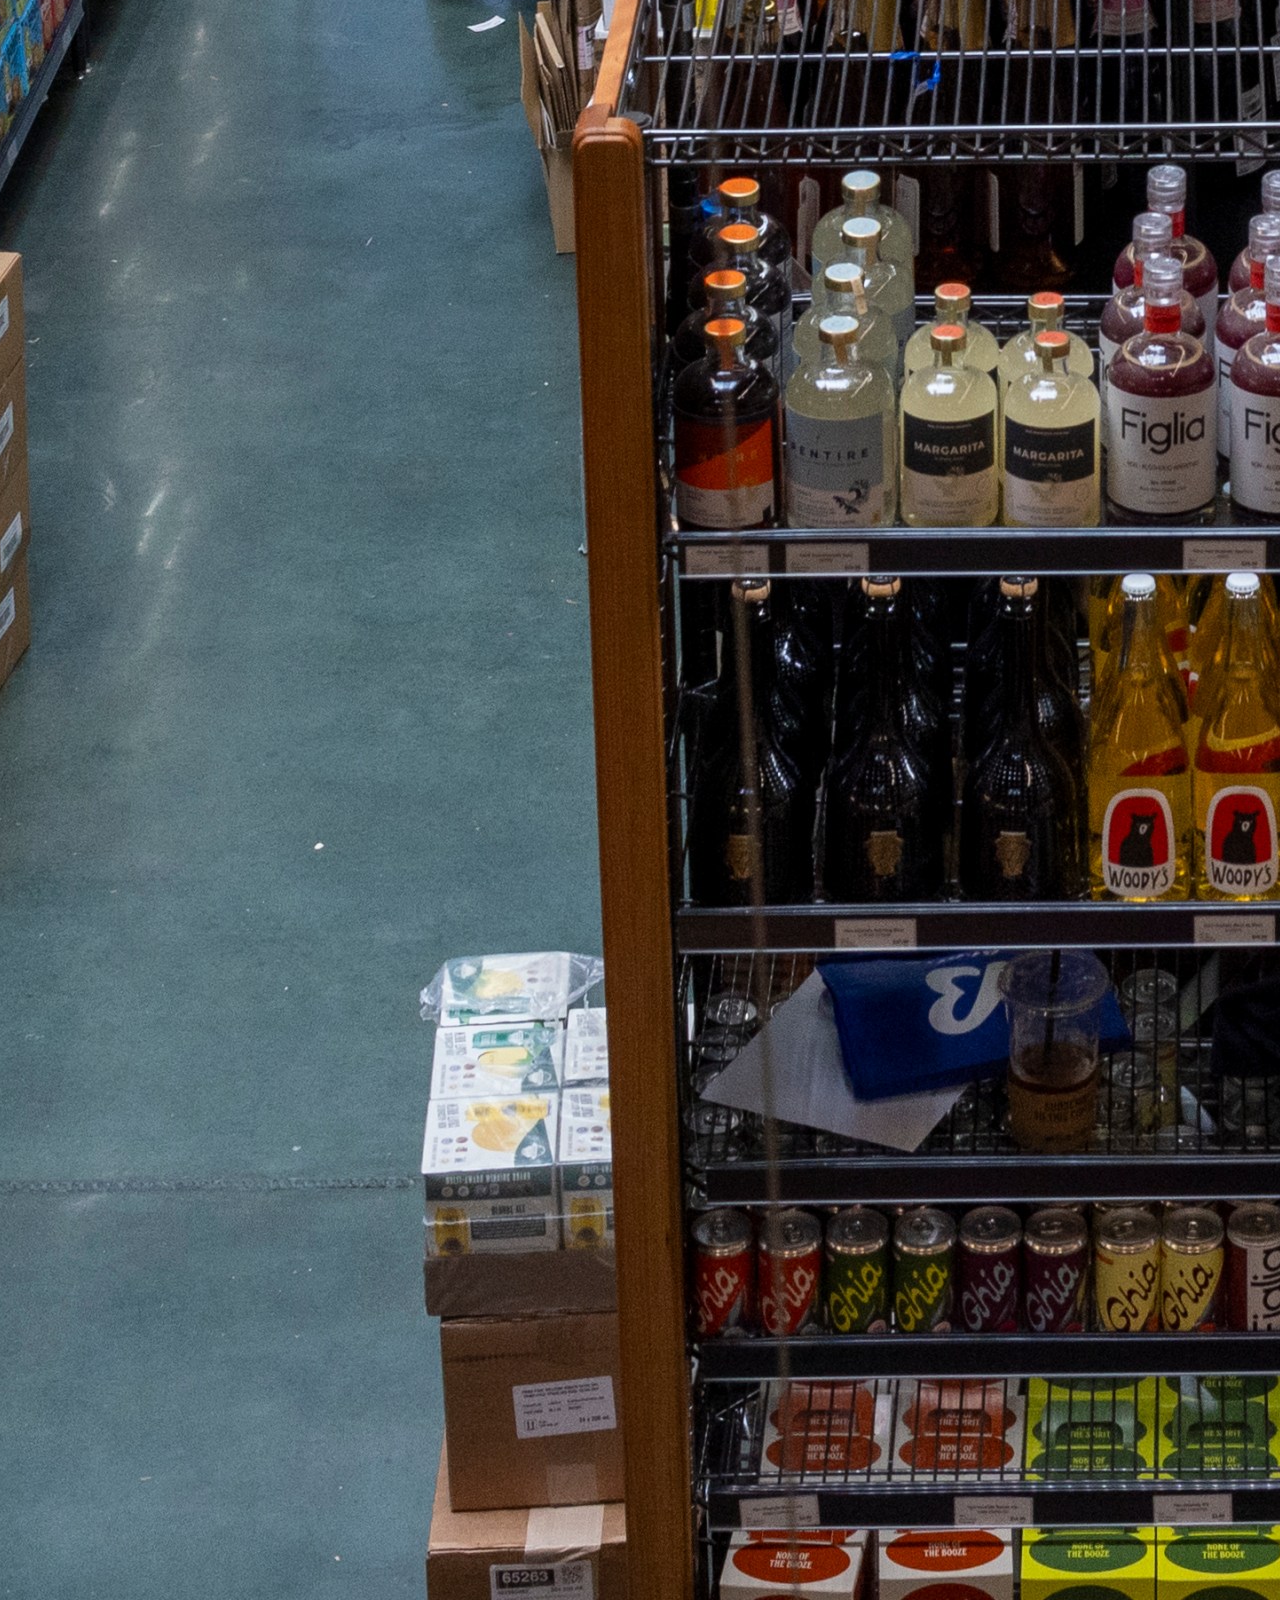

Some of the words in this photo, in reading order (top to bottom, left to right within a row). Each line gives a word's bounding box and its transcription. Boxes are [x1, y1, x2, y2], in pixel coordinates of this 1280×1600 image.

[1121, 407, 1206, 456] Figlia
[912, 439, 987, 457] MARGARITA
[1012, 444, 1085, 462] MARGARITA
[1108, 863, 1170, 890] WOODY'S
[1209, 860, 1273, 888] WOODY'S
[830, 1261, 882, 1331] Ghia
[896, 1261, 949, 1331] Ghia
[963, 1261, 1017, 1331] Ghia
[1026, 1261, 1080, 1331] Ghia
[1162, 1261, 1215, 1331] Ghia
[776, 1551, 797, 1560] NONE
[798, 1551, 811, 1560] OF
[923, 1547, 940, 1558] THE
[941, 1547, 968, 1558] BOOZE
[1066, 1549, 1083, 1559] THE
[1084, 1549, 1111, 1559] BOOZE
[1202, 1550, 1219, 1560] THE
[1220, 1550, 1246, 1560] BOOZE
[1207, 1543, 1229, 1552] NONE
[1230, 1543, 1241, 1552] OF
[769, 1559, 786, 1570] THE
[501, 1570, 550, 1586] 65263
